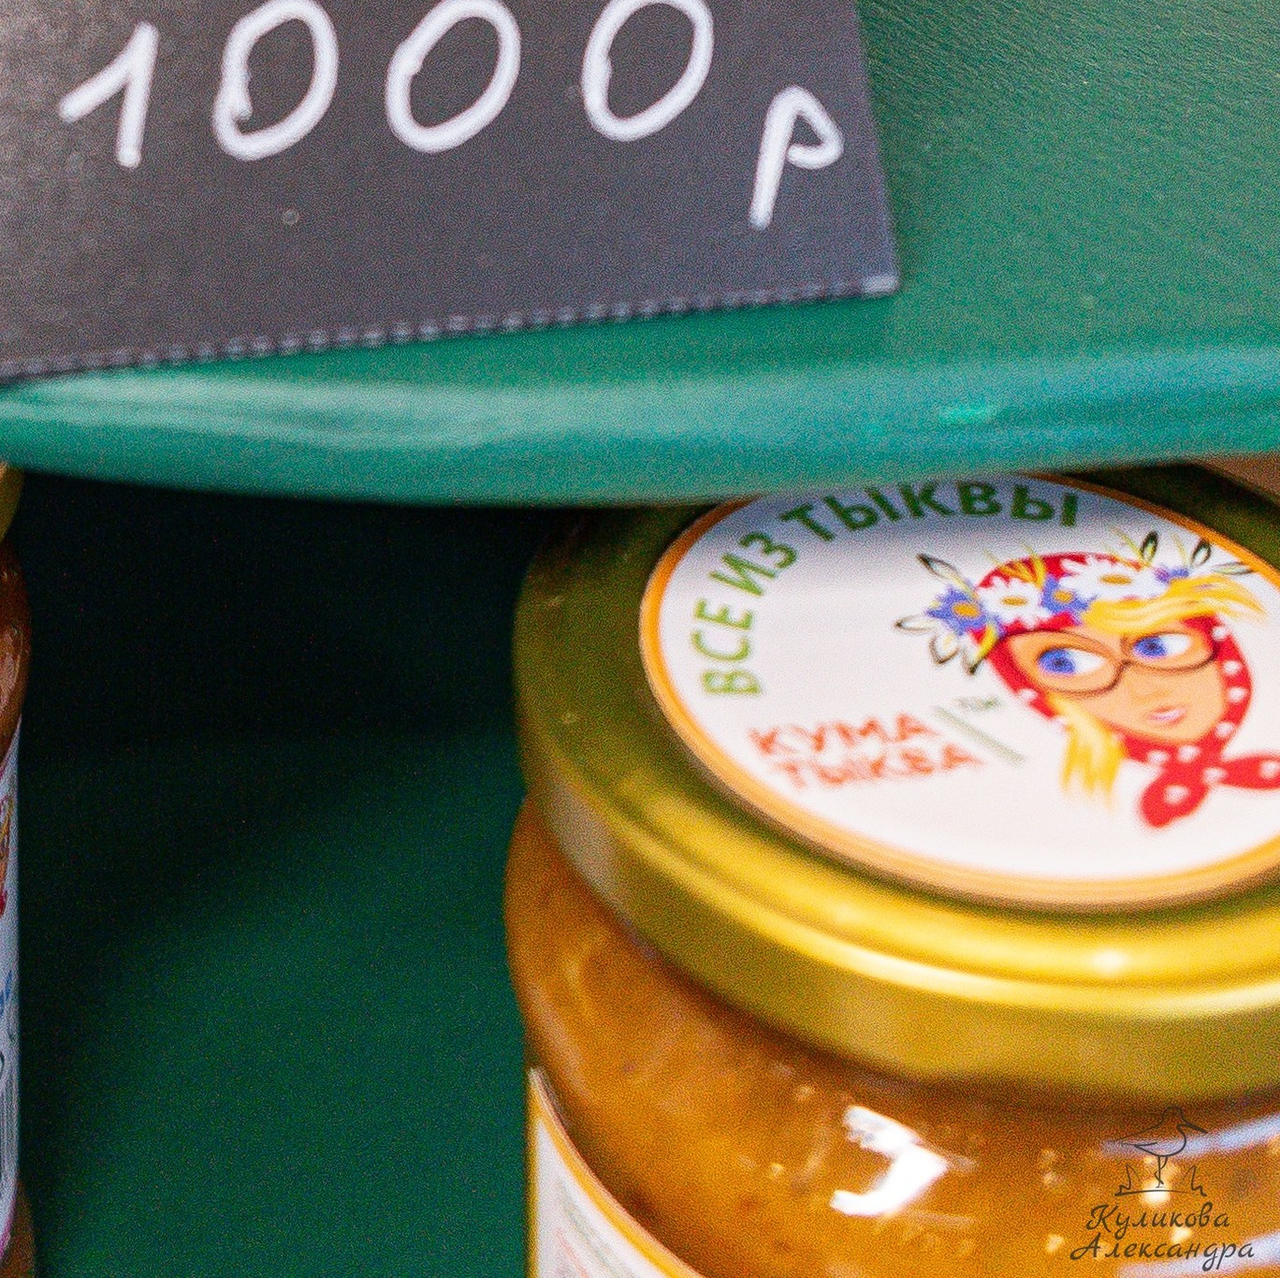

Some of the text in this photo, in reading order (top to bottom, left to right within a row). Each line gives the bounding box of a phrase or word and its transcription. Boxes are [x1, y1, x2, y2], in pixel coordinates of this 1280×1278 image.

[689, 479, 1080, 698] ВСЕ ИЗ ТЫКВЫ
[747, 711, 943, 758] КУМА
[773, 740, 985, 793] ТЫКВА
